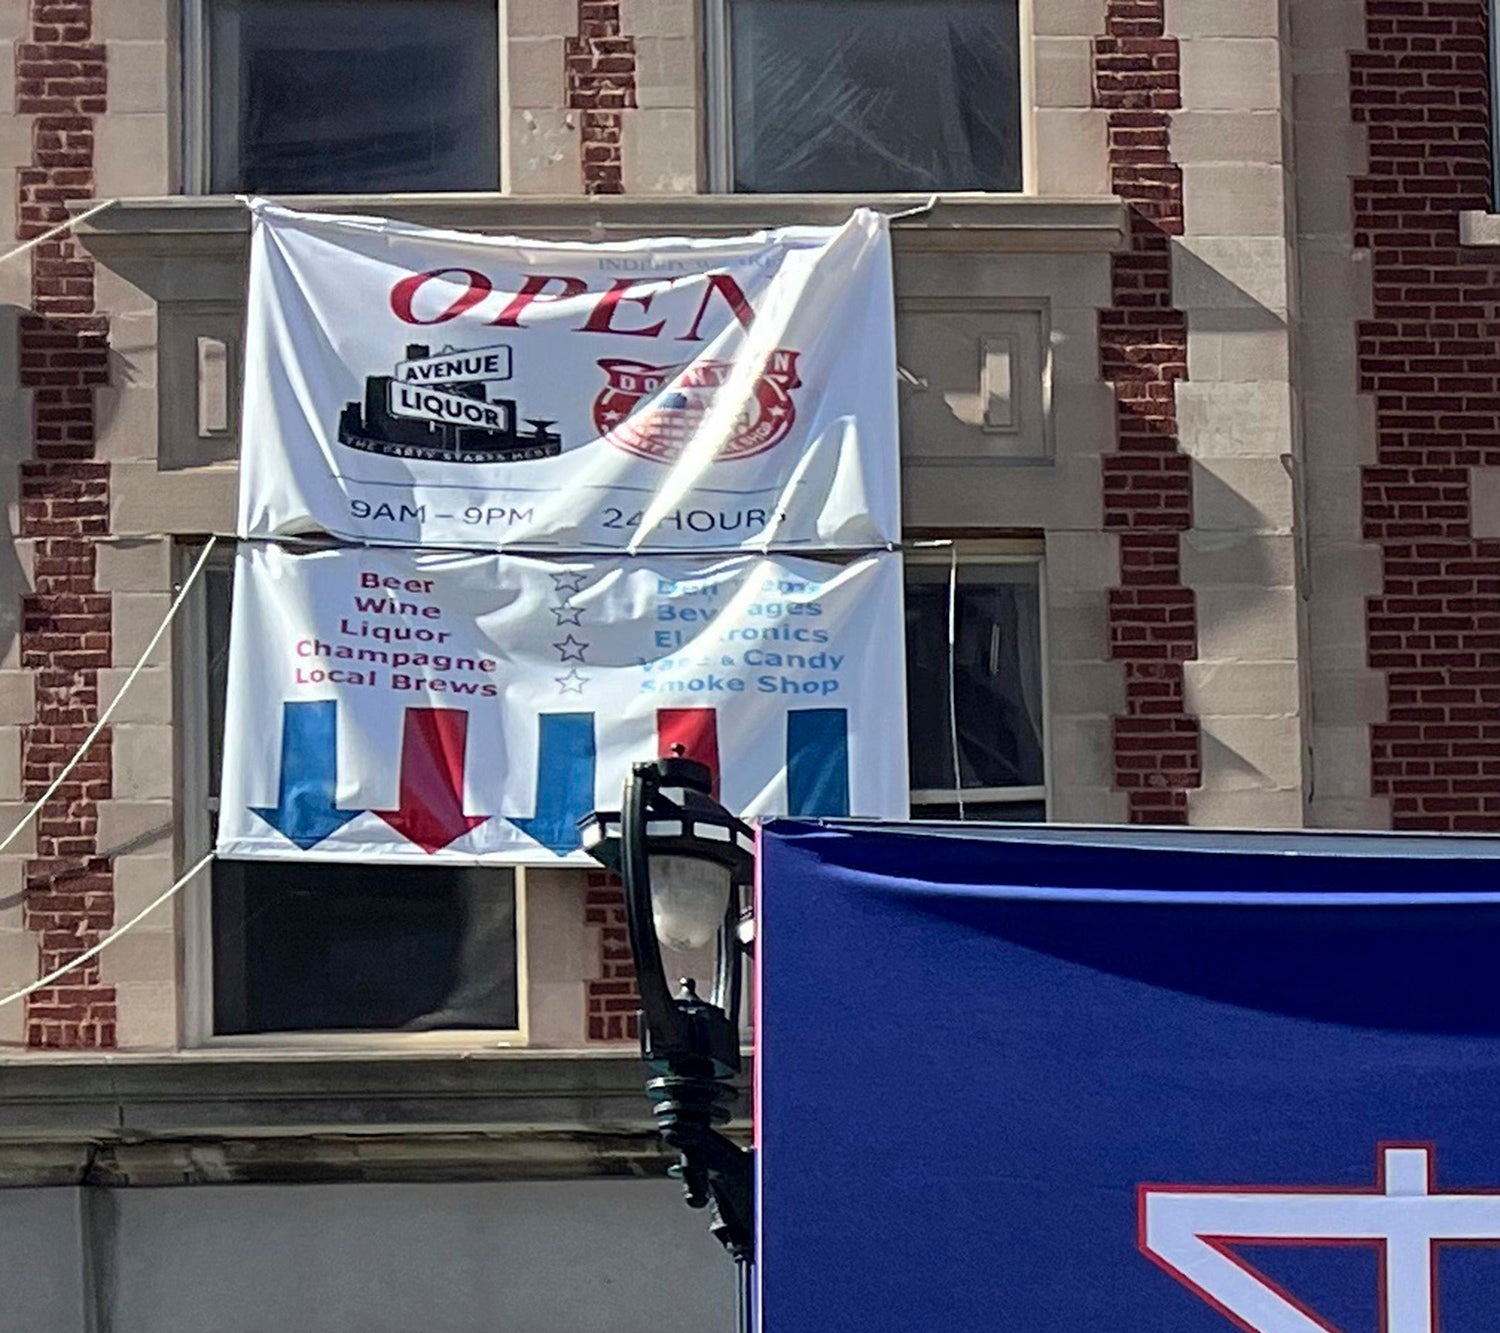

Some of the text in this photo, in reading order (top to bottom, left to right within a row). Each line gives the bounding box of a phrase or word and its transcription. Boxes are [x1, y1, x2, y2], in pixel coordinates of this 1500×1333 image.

[405, 354, 500, 382] AVENUE
[401, 388, 500, 427] LIQUOR
[350, 499, 426, 524] 9AM
[462, 506, 535, 526] 9PM
[660, 507, 787, 533] HOUR
[360, 571, 435, 594] Beer
[354, 595, 441, 620] Wine
[657, 602, 823, 622] Bevages
[340, 618, 453, 644] Liquor
[654, 624, 829, 649] Elronics
[296, 638, 498, 673] Champagne
[742, 649, 846, 672] Candy
[295, 667, 499, 698] Local Brews
[756, 674, 840, 697] Shop
